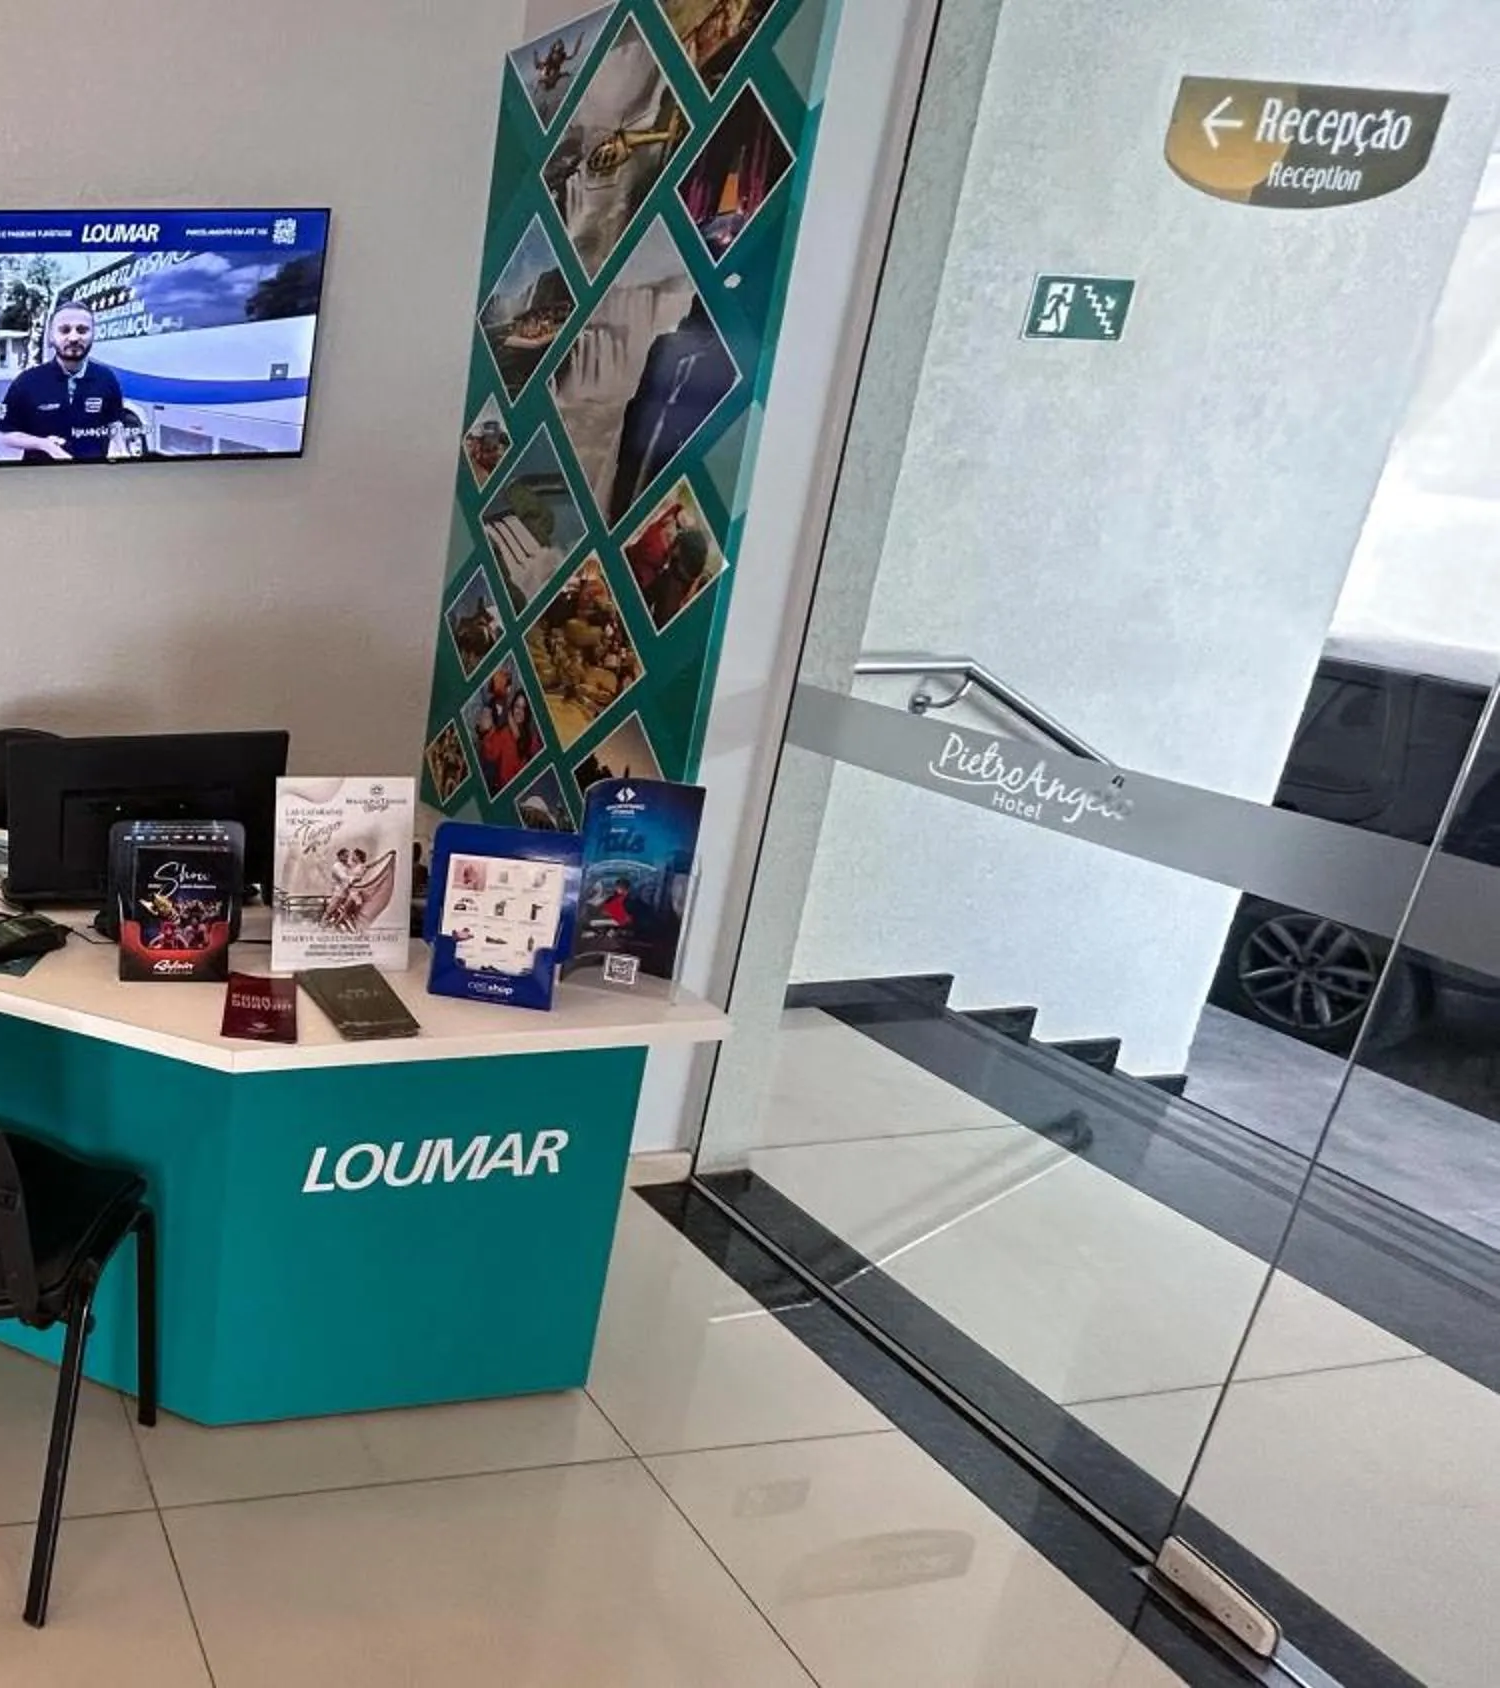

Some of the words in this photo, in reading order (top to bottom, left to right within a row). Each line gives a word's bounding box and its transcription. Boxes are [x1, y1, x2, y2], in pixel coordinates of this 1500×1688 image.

[1256, 98, 1413, 156] Recepção
[1267, 161, 1362, 193] Reception
[81, 223, 161, 243] LOUMAR
[991, 790, 1043, 821] Hotel
[153, 861, 213, 898] Show
[302, 1129, 569, 1193] LOUMAR
